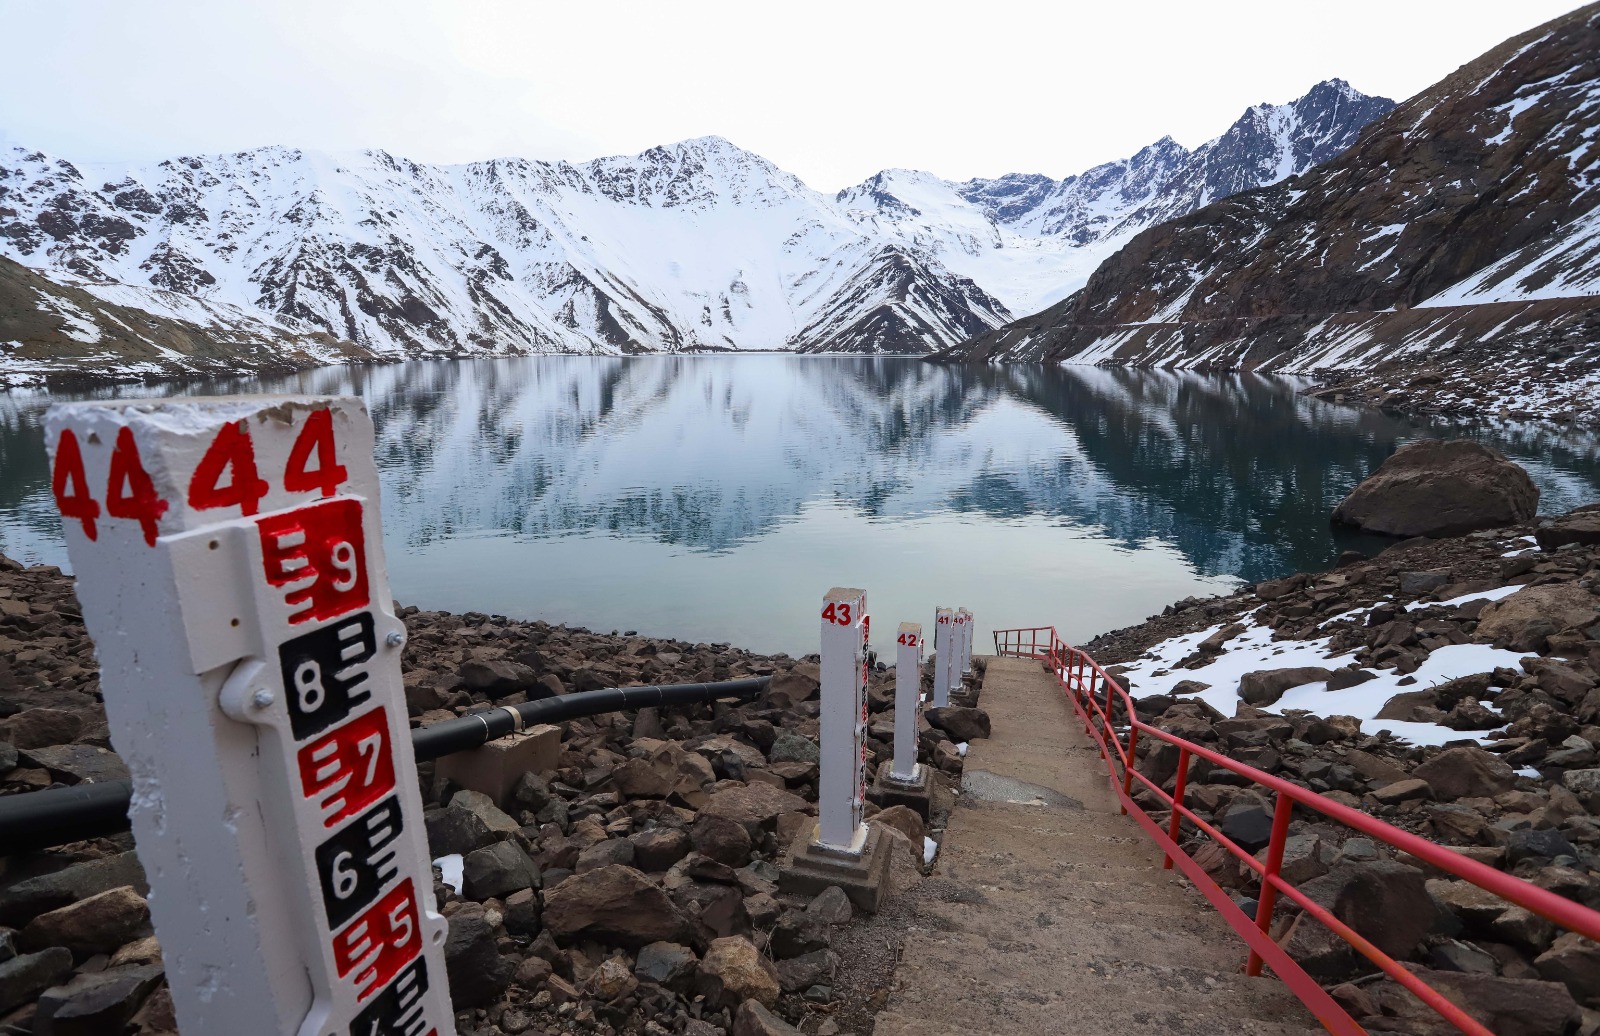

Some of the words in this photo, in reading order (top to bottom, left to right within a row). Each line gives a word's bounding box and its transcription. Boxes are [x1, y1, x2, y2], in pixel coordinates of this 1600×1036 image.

[52, 426, 169, 548] 44
[188, 407, 348, 516] 44
[330, 540, 356, 593] 9
[821, 602, 852, 626] 43
[938, 616, 949, 625] 41
[954, 617, 964, 625] 40
[897, 633, 917, 647] 42
[294, 658, 325, 713] 8
[358, 731, 382, 787] 7
[332, 851, 359, 899] 6
[388, 897, 413, 948] 5
